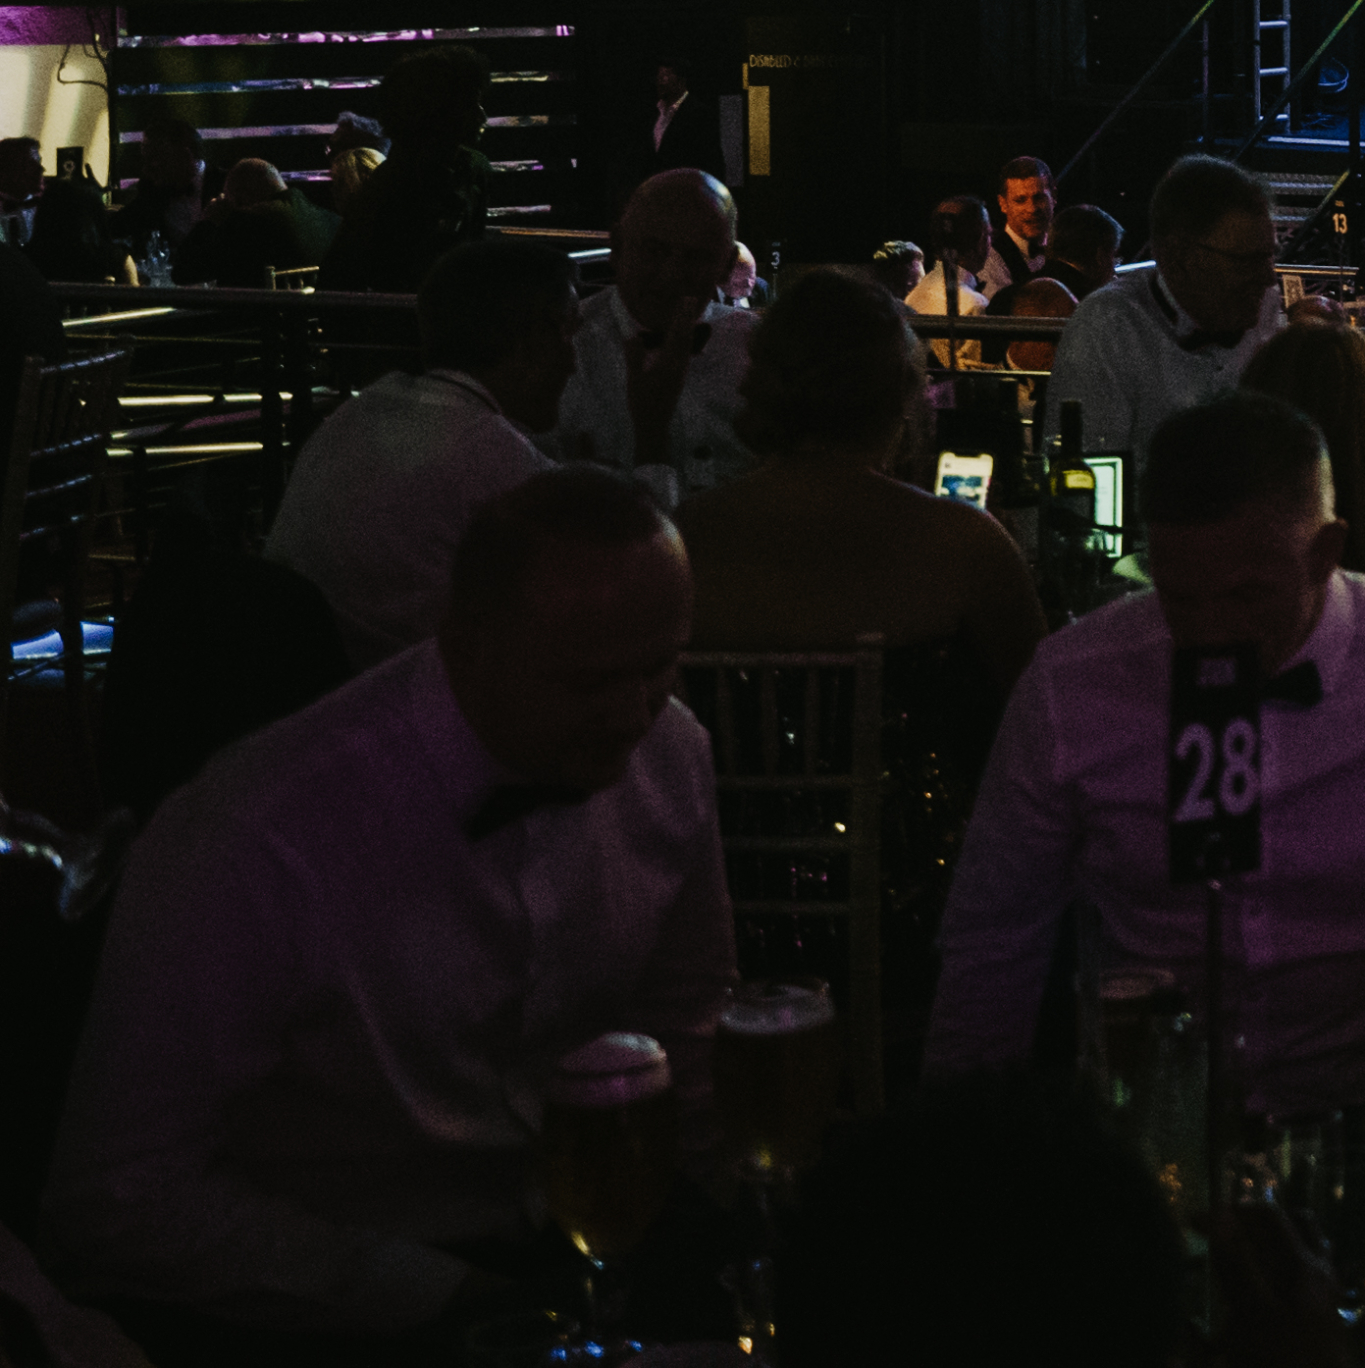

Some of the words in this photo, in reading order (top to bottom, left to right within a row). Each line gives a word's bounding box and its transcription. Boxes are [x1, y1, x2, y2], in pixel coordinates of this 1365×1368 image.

[1332, 213, 1348, 234] 13
[771, 251, 780, 267] 3
[1173, 716, 1259, 824] 28
